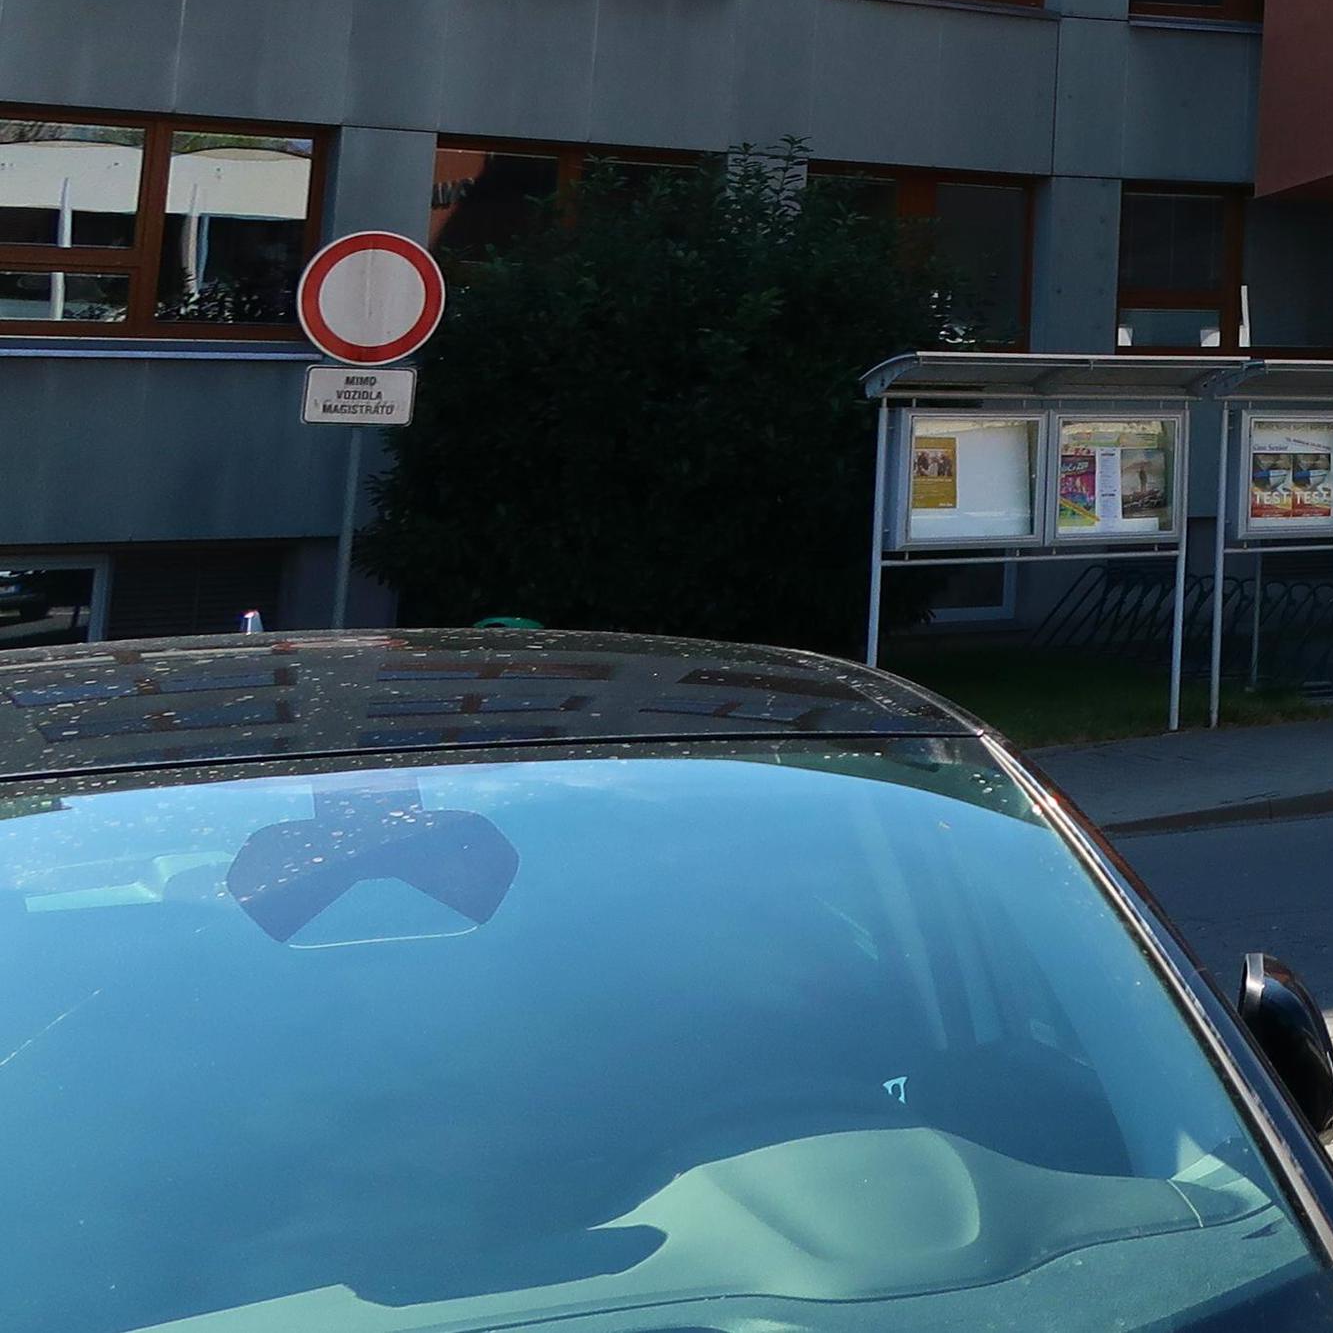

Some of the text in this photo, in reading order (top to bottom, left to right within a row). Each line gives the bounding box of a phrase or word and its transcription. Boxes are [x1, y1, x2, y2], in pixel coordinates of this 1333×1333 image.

[345, 376, 376, 386] MIMO
[336, 390, 382, 400] VOZIDLA
[1254, 491, 1289, 504] TEST
